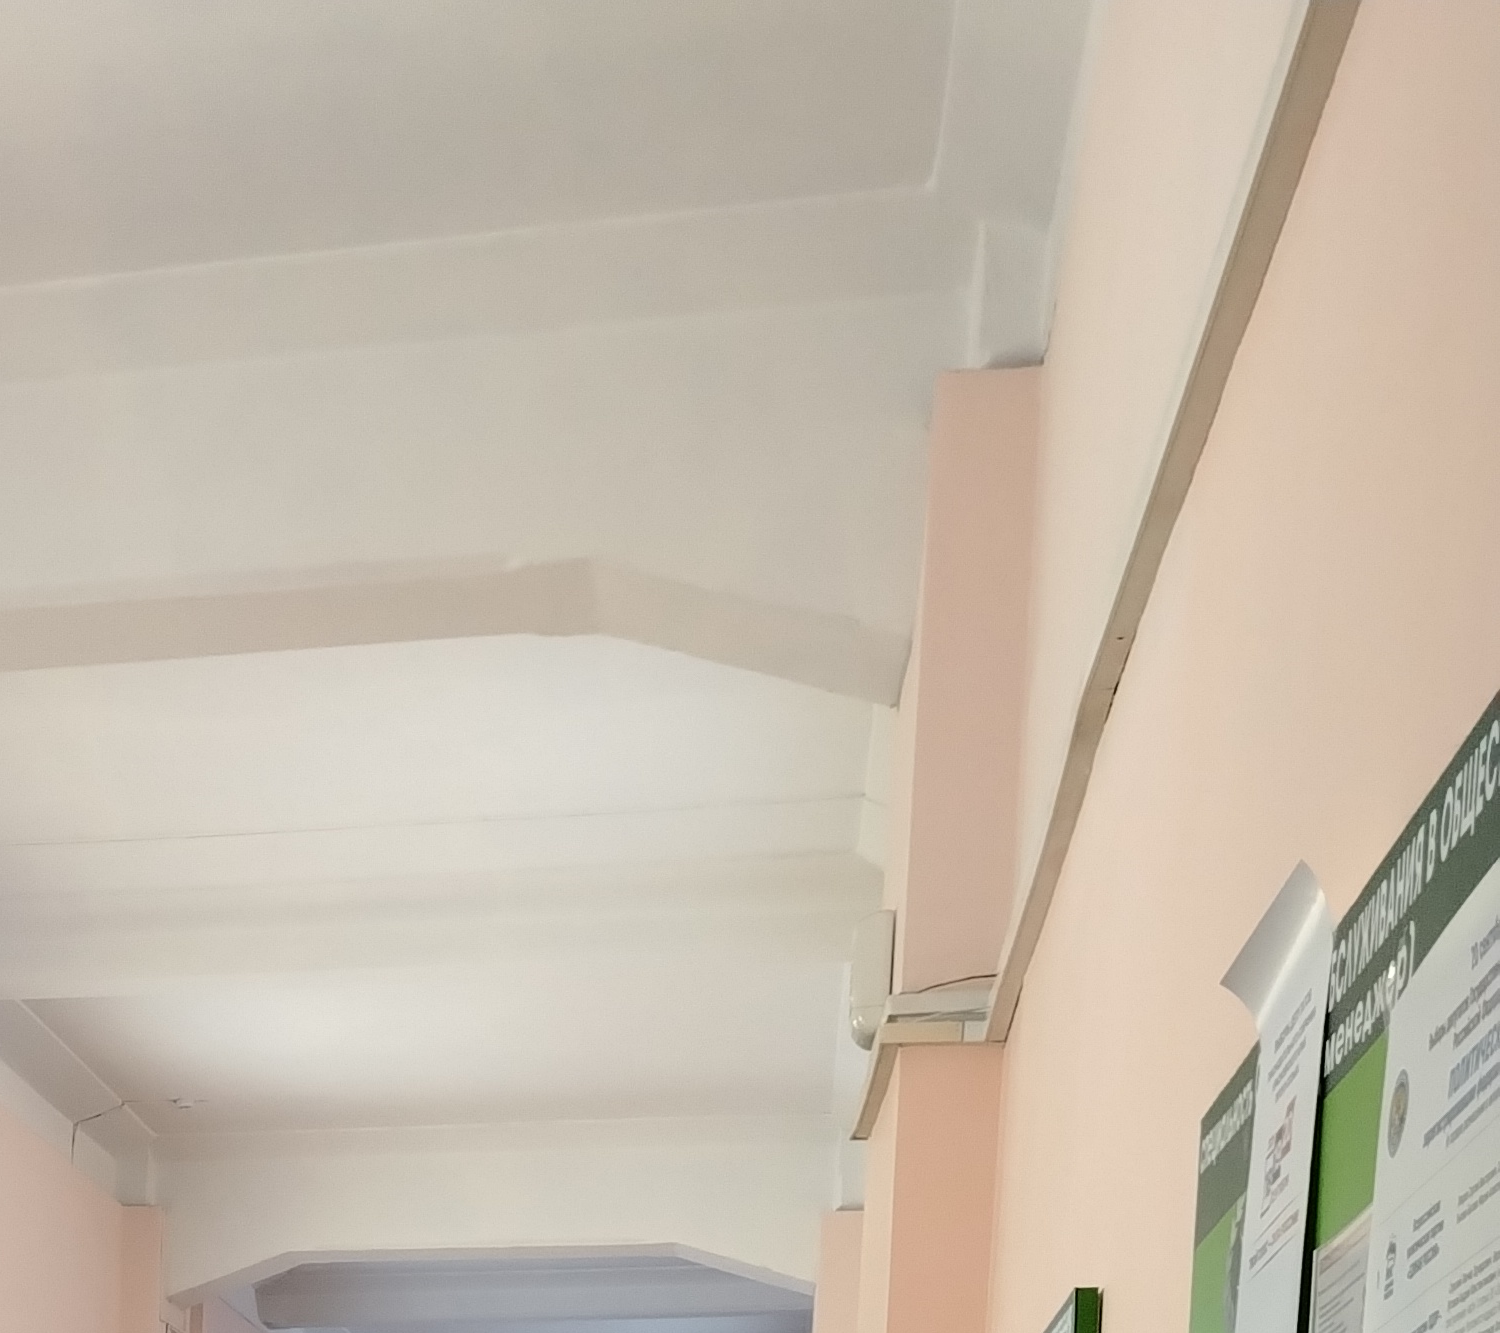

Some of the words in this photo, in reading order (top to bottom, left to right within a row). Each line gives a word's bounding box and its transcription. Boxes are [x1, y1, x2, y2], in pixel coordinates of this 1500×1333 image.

[1328, 822, 1426, 1014] БСЛУЖИВАНИЯ
[1426, 809, 1437, 884] В
[1440, 720, 1500, 863] ОБЩЕС
